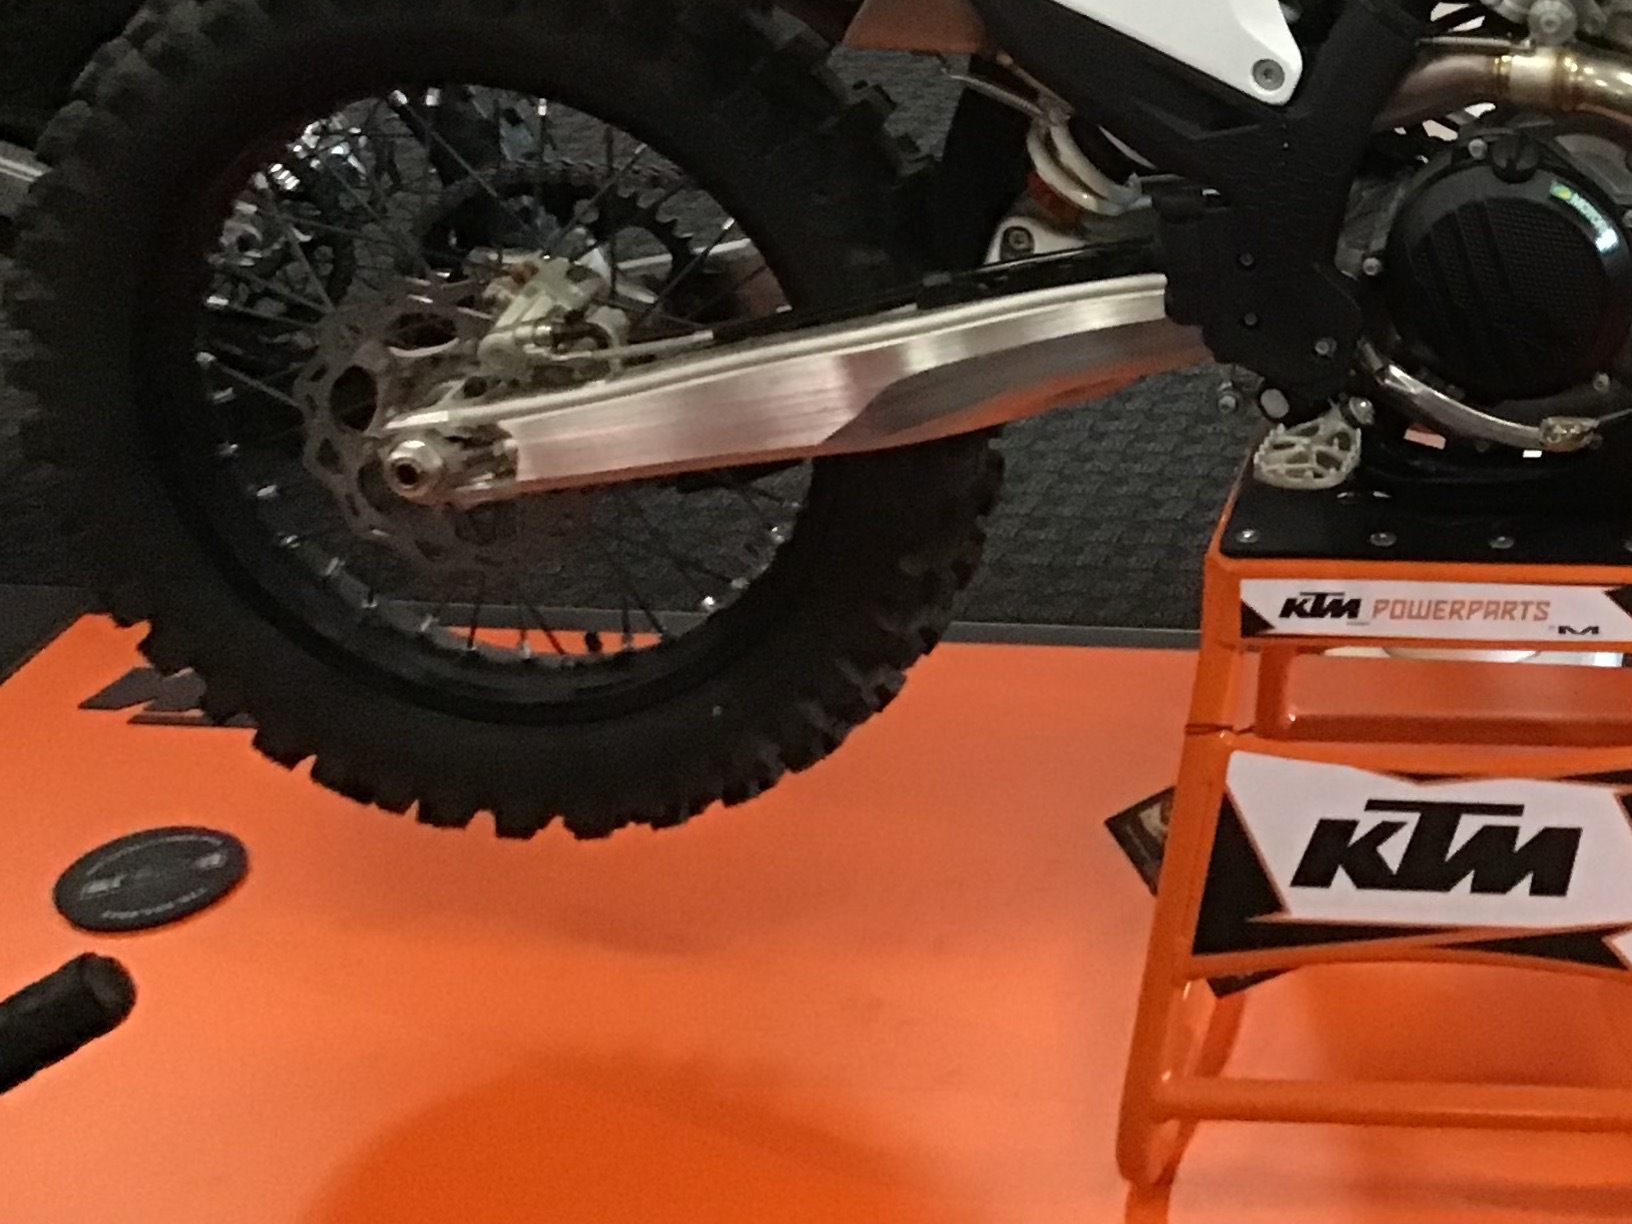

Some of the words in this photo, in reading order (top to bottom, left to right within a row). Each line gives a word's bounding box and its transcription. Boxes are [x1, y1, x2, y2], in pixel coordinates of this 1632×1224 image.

[1278, 591, 1363, 619] KTM
[1371, 598, 1551, 622] POWERPARTS
[1290, 798, 1583, 898] KTM
